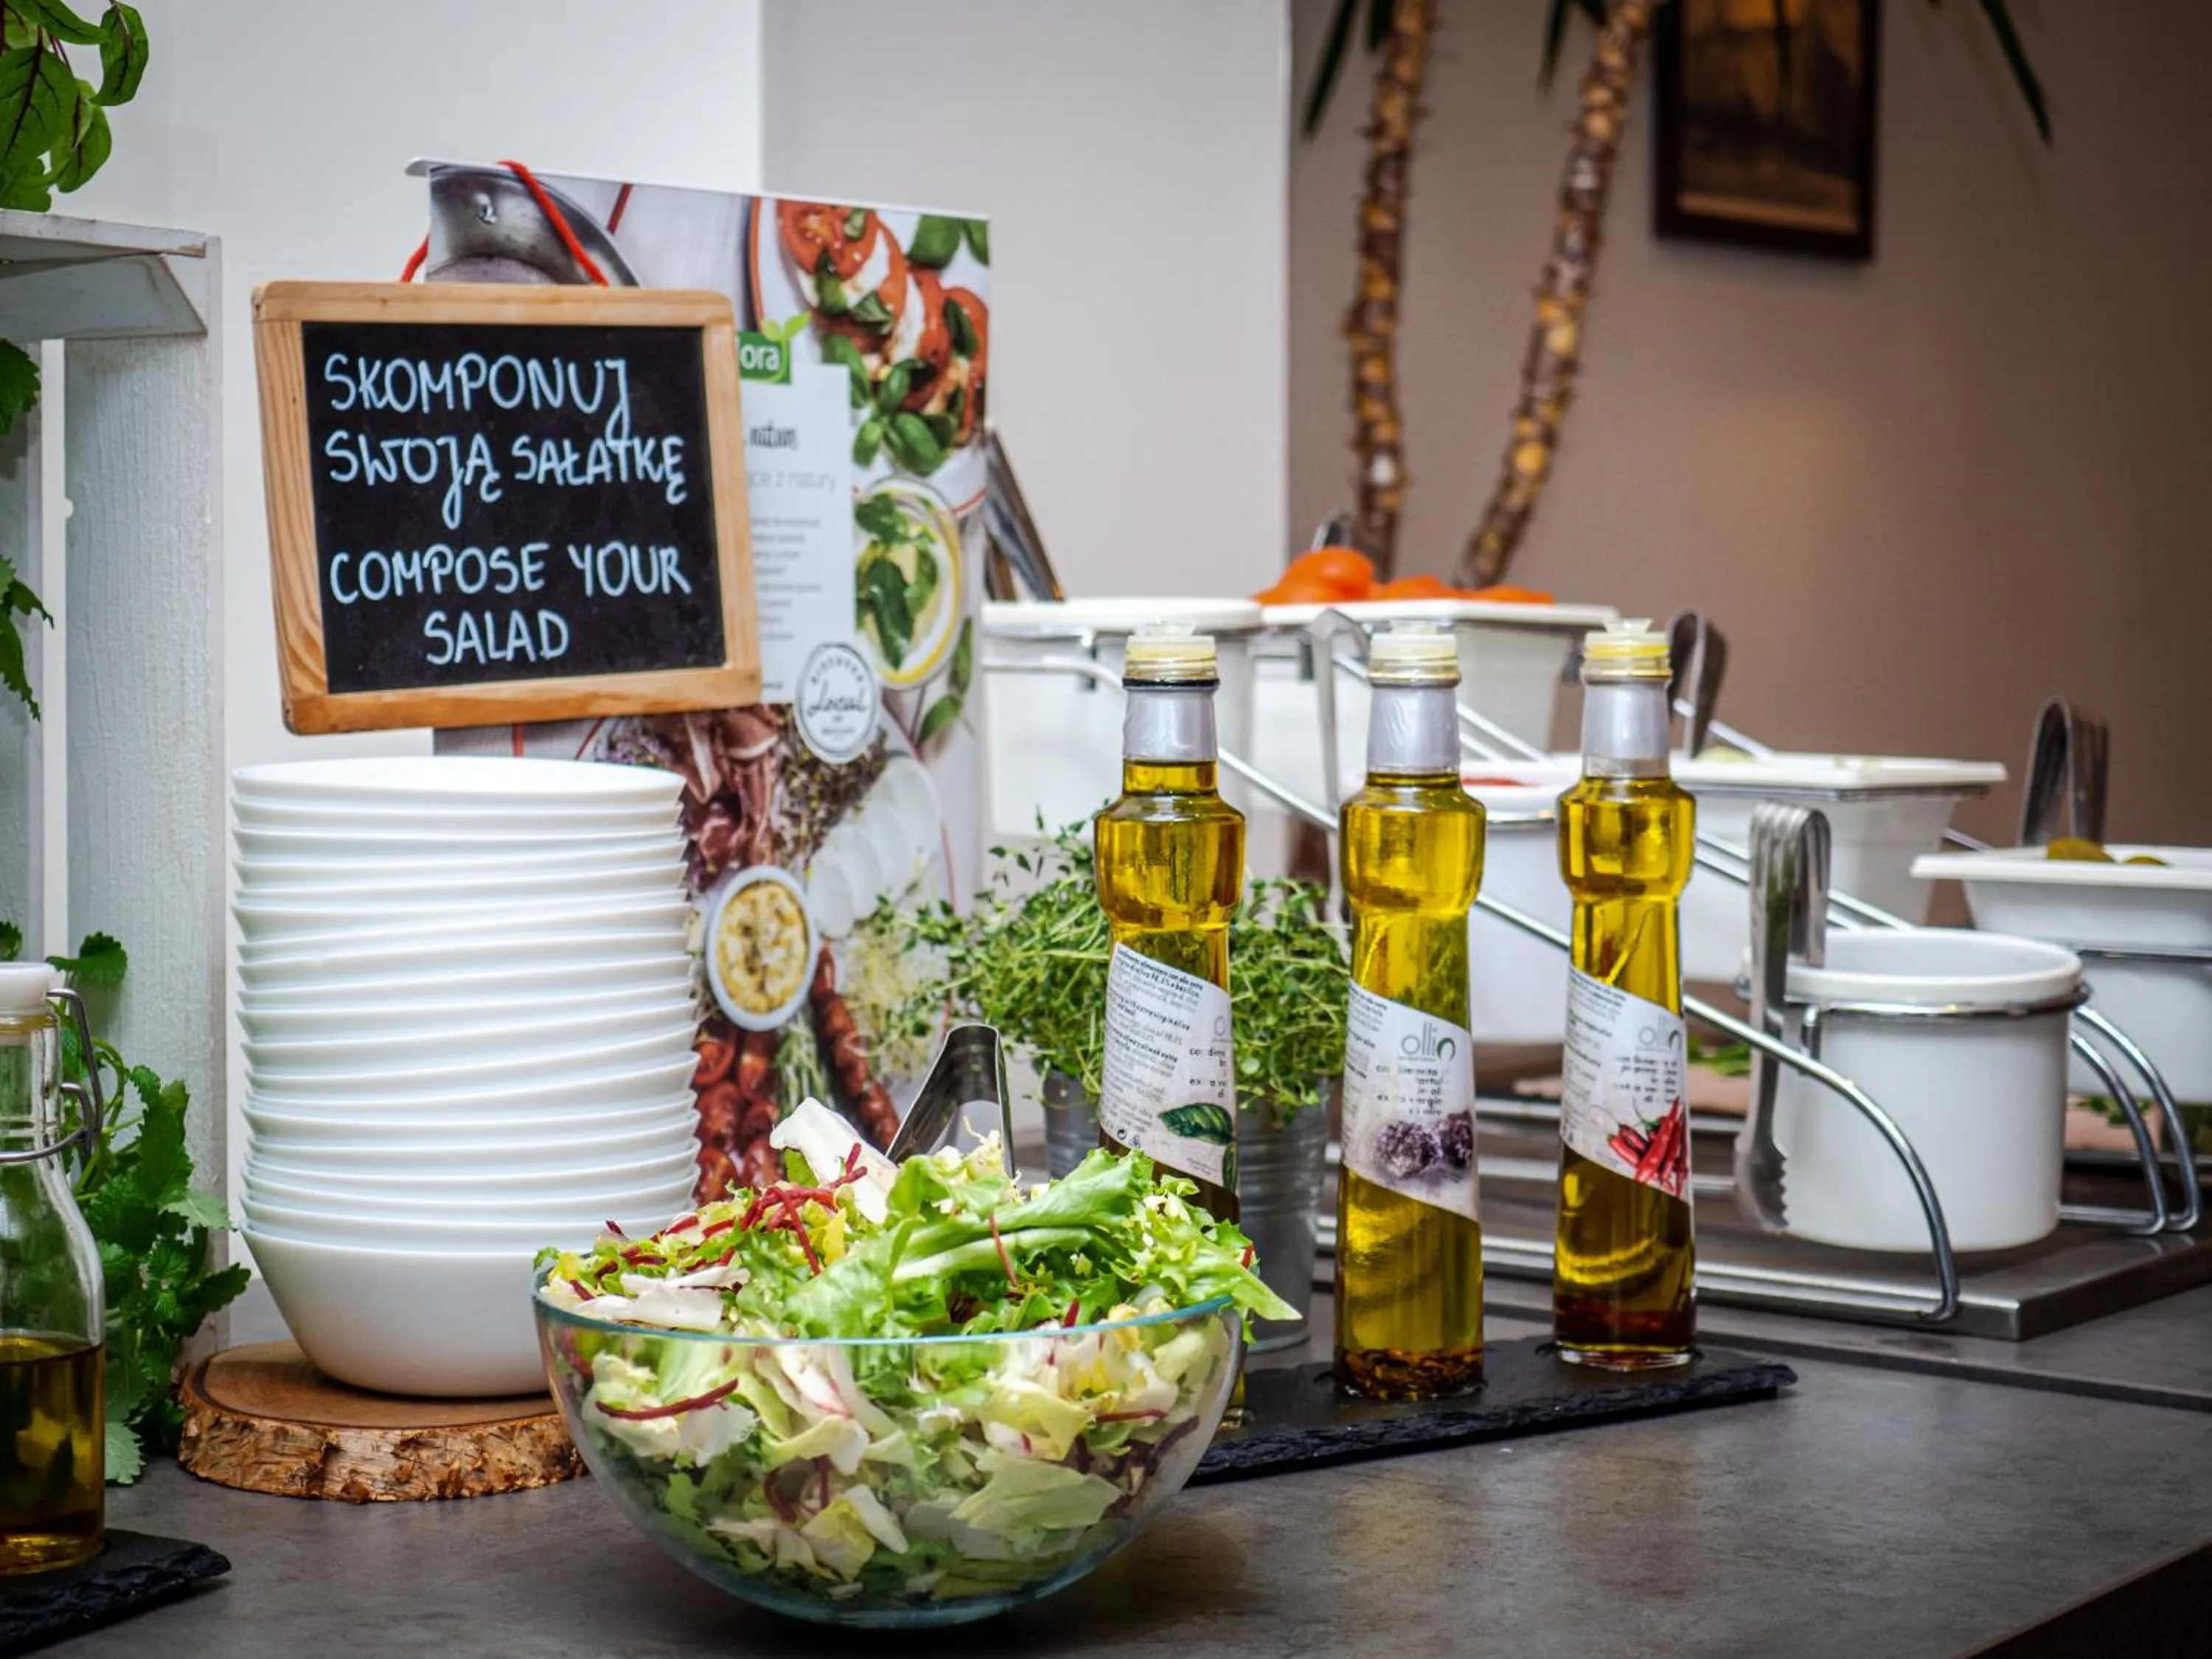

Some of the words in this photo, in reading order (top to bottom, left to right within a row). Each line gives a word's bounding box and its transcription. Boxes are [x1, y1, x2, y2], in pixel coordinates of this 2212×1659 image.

[324, 352, 631, 447] SKOMPONUJ
[324, 430, 502, 529] SWOJĄ
[511, 434, 687, 505] SAŁATKĘ
[330, 542, 550, 605] COMPOSE
[566, 540, 692, 597] YOUR
[423, 609, 569, 666] SALAD
